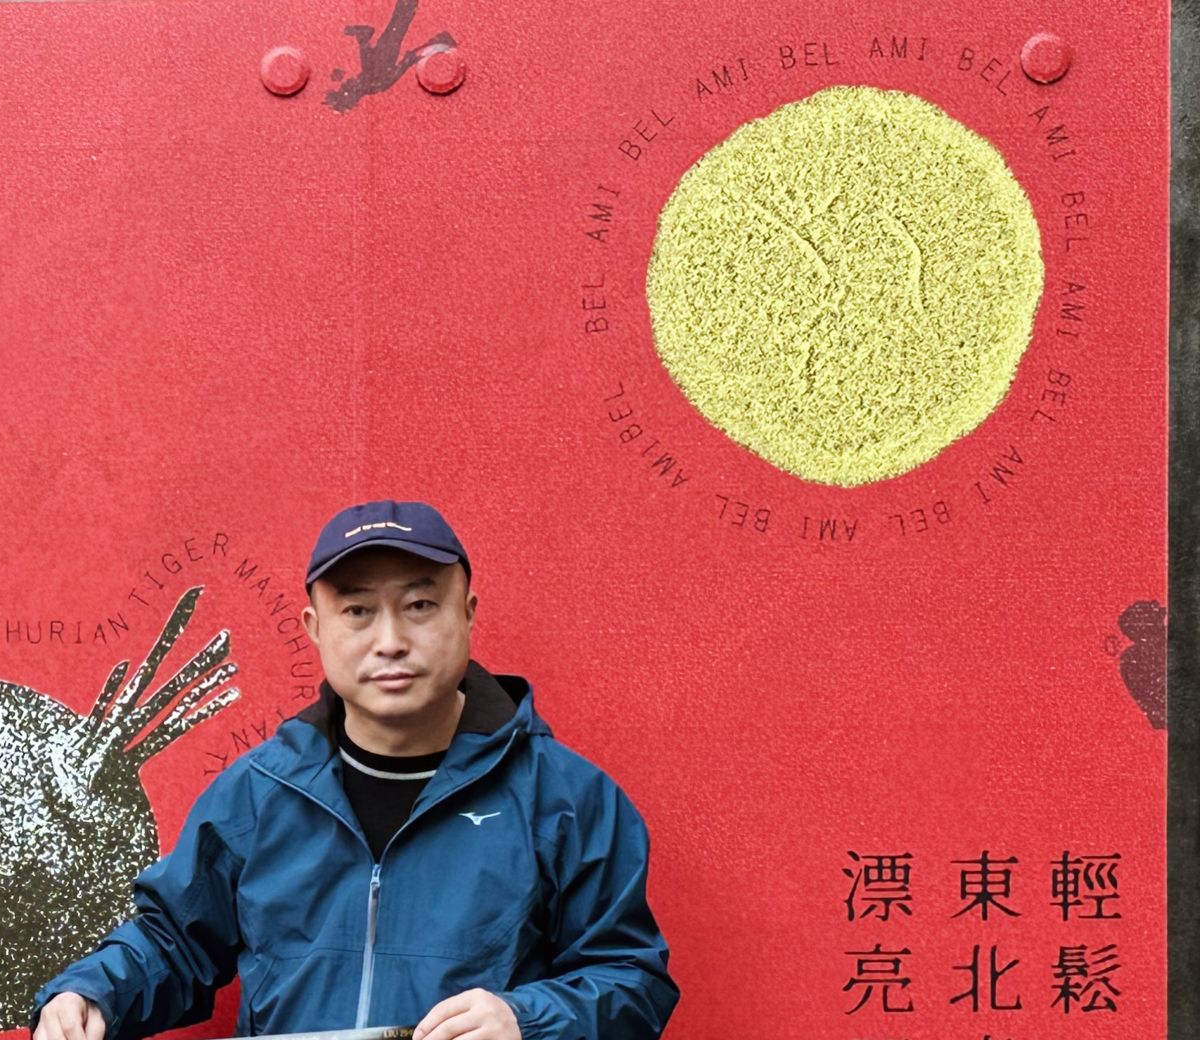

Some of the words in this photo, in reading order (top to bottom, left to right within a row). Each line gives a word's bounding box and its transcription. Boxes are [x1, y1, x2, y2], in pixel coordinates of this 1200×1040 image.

[779, 42, 839, 70] BEL
[868, 36, 929, 61] AMI
[957, 47, 1009, 96] BEL
[693, 58, 750, 99] AMI
[618, 110, 674, 161] BEL
[1029, 104, 1076, 162] AMI
[585, 184, 621, 243] AMI
[1061, 191, 1088, 253] BEL
[582, 274, 608, 333] BEL
[1055, 281, 1086, 340] AMI
[604, 381, 643, 444] BEL
[1031, 368, 1071, 424] BEL
[639, 438, 689, 489] AMI
[973, 445, 1024, 505] AMI
[715, 494, 771, 533] BEL
[801, 516, 858, 542] AMI
[888, 500, 951, 534] BEL
[128, 532, 230, 607] TIGER
